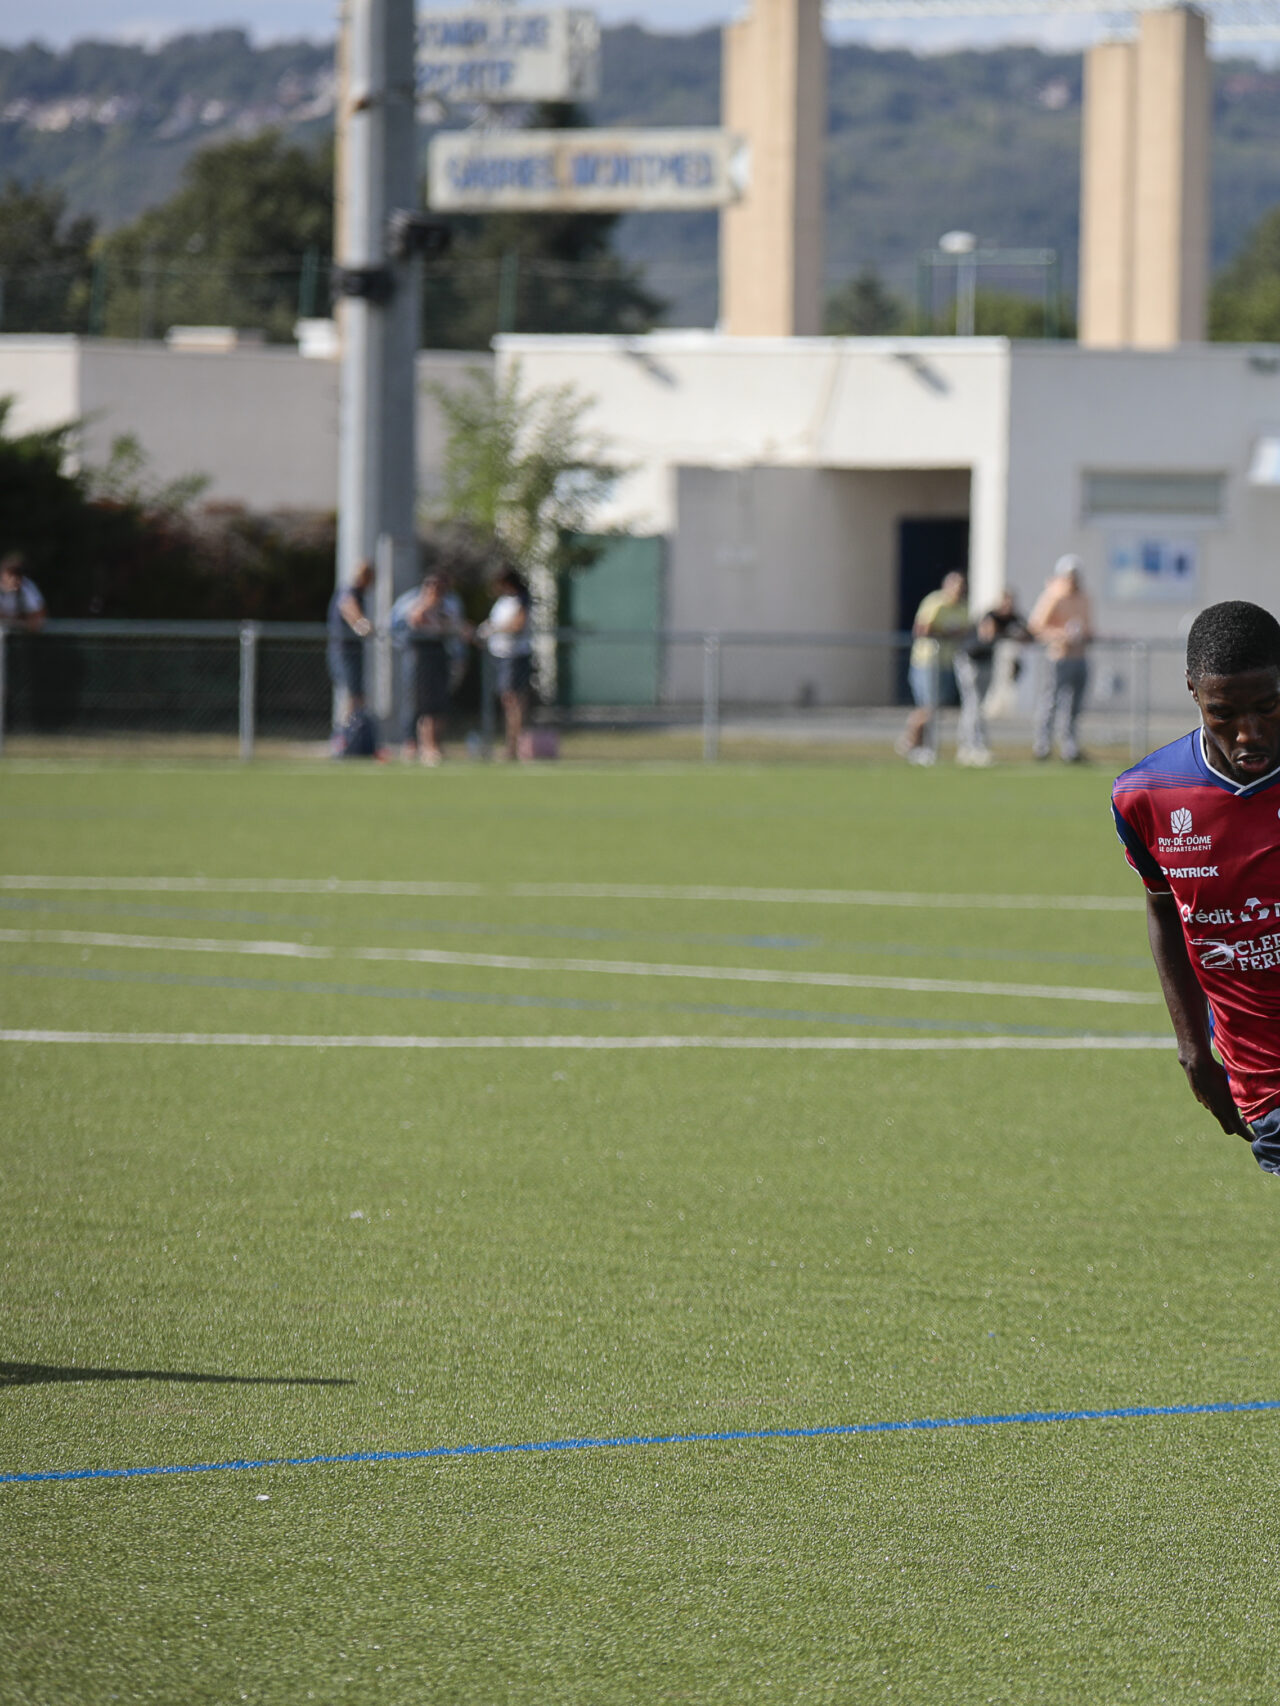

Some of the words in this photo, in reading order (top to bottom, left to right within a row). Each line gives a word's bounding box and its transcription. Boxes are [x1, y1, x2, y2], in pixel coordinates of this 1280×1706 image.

[1158, 834, 1212, 846] PUY-DE-DÔME
[1169, 866, 1219, 879] PATRICK
[1180, 903, 1235, 925] Crédit
